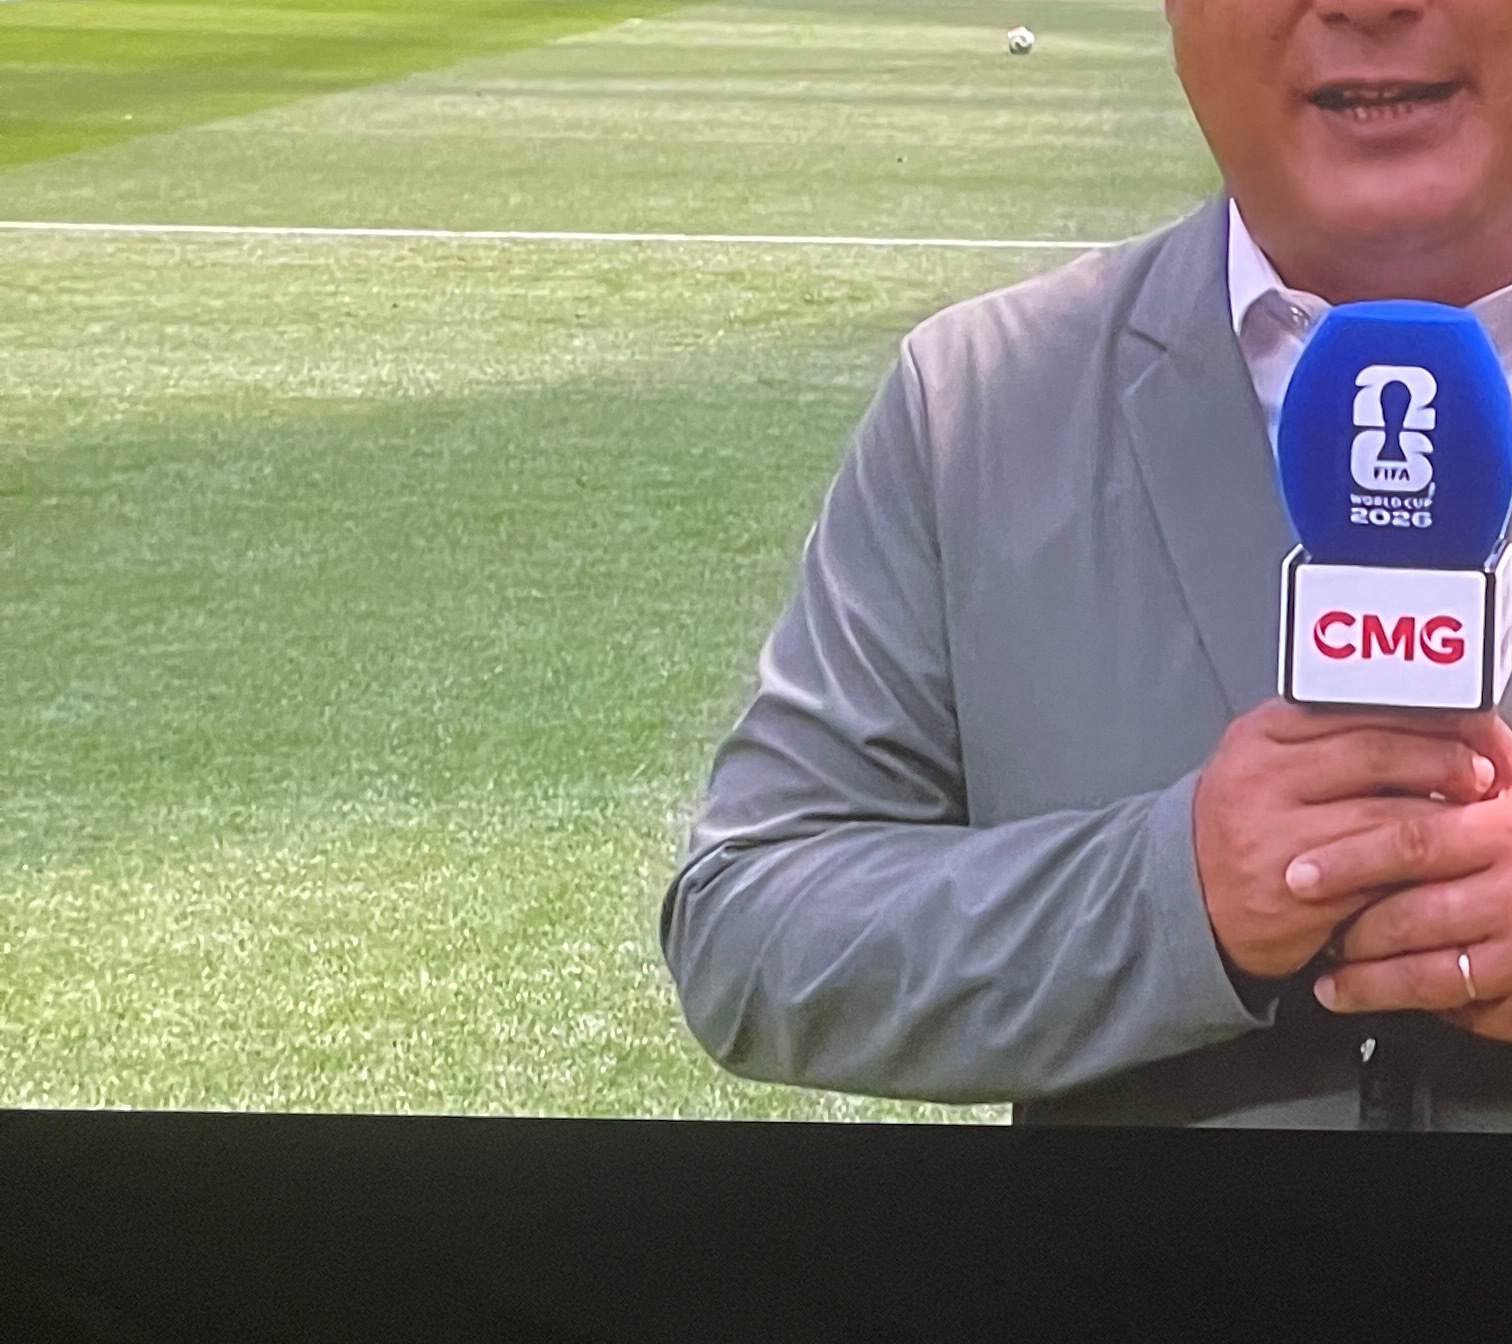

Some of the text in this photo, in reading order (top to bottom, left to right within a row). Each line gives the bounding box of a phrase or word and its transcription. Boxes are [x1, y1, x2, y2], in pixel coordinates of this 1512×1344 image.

[1373, 466, 1411, 481] FIFA
[1350, 493, 1433, 510] WORLD CUP
[1350, 507, 1433, 528] 2026
[1313, 610, 1466, 665] CMG
